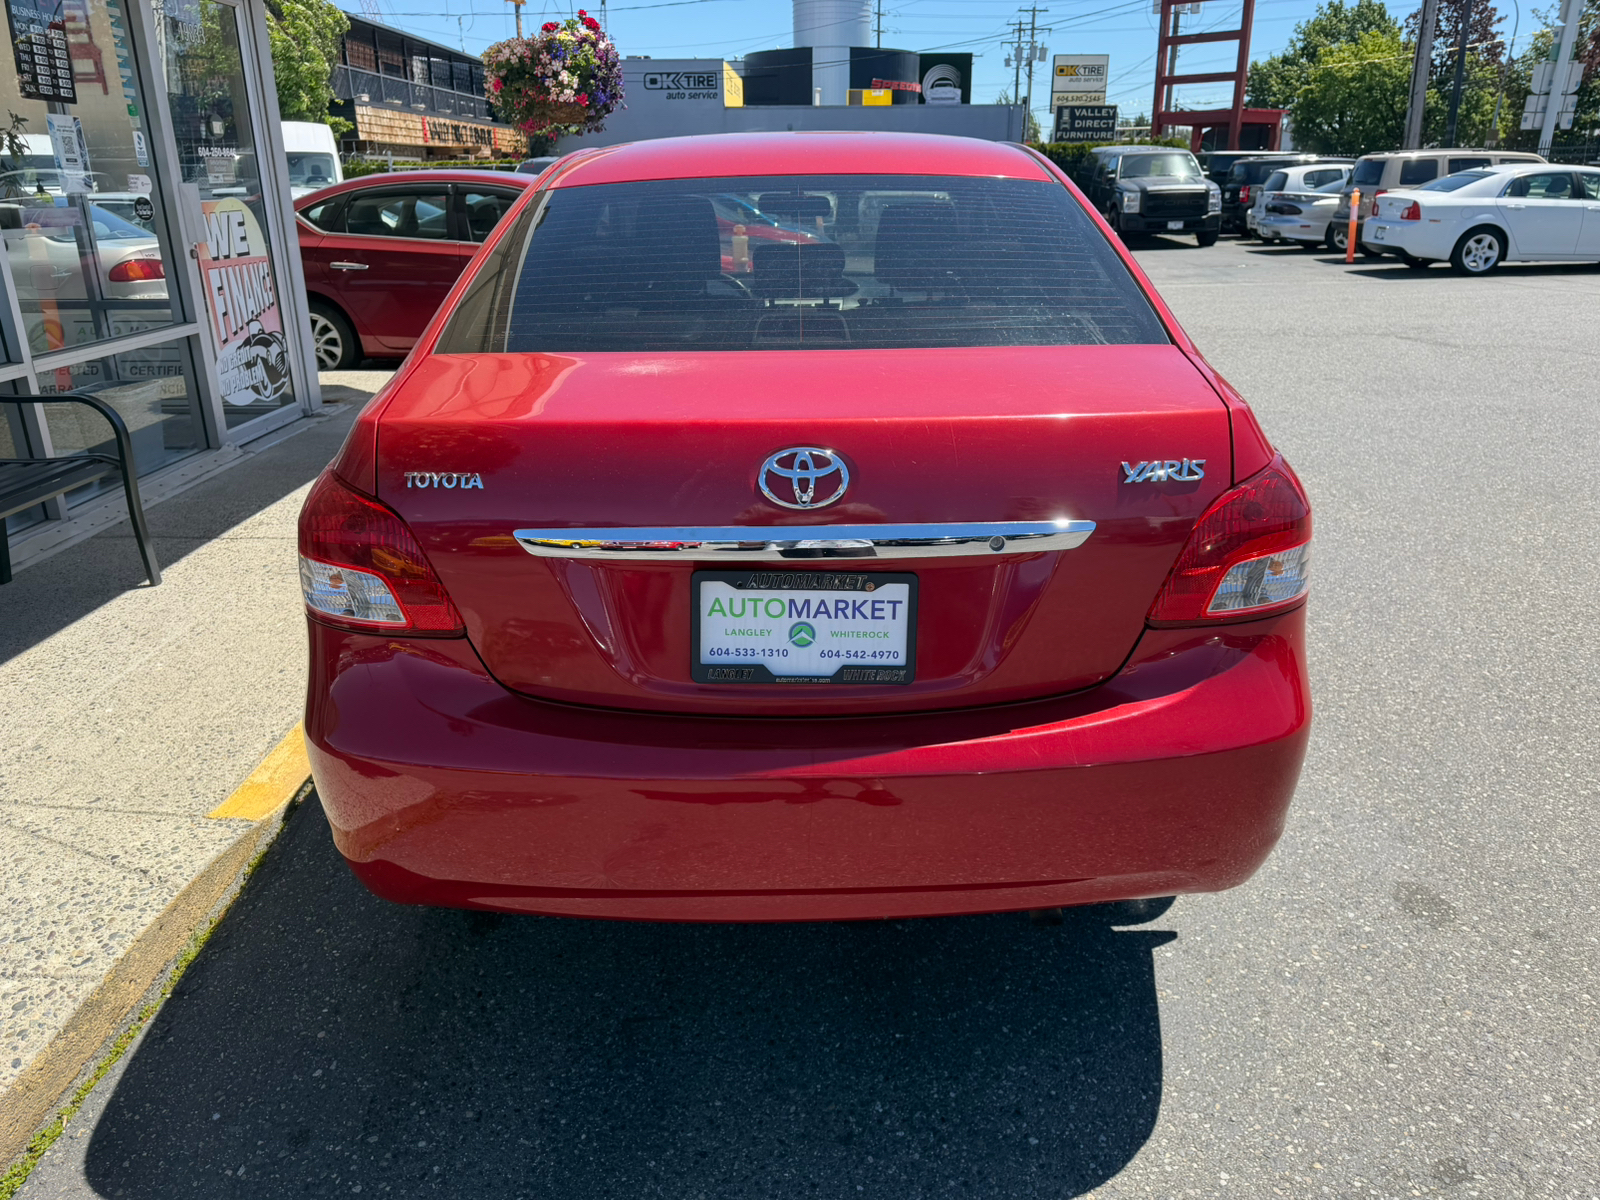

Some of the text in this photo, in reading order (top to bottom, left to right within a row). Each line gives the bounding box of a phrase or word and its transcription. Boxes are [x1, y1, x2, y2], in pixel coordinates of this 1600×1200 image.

[11, 5, 63, 24] BUSINESS HOURS
[1082, 66, 1103, 75] TIRE
[684, 75, 715, 87] TIRE
[666, 91, 718, 100] auto service
[1074, 108, 1116, 117] VALLEY
[1074, 119, 1115, 128] DIRECT
[1056, 131, 1114, 139] FURNITURE
[203, 210, 250, 261] WE
[207, 261, 275, 345] FINANCE
[129, 365, 184, 376] CERTIFIE
[1121, 457, 1206, 484] YARIS
[403, 471, 484, 490] TOYOTA
[746, 573, 868, 590] AUTOMARKET
[707, 597, 903, 620] AUTOMARKET
[724, 628, 773, 637] LANGLEY
[830, 630, 890, 639] WHITEROCK
[709, 647, 789, 658] 604-533-1310
[819, 649, 900, 660] 604-542-4970
[707, 668, 754, 680] LANGLEY
[843, 669, 906, 682] WHITE ROCK
